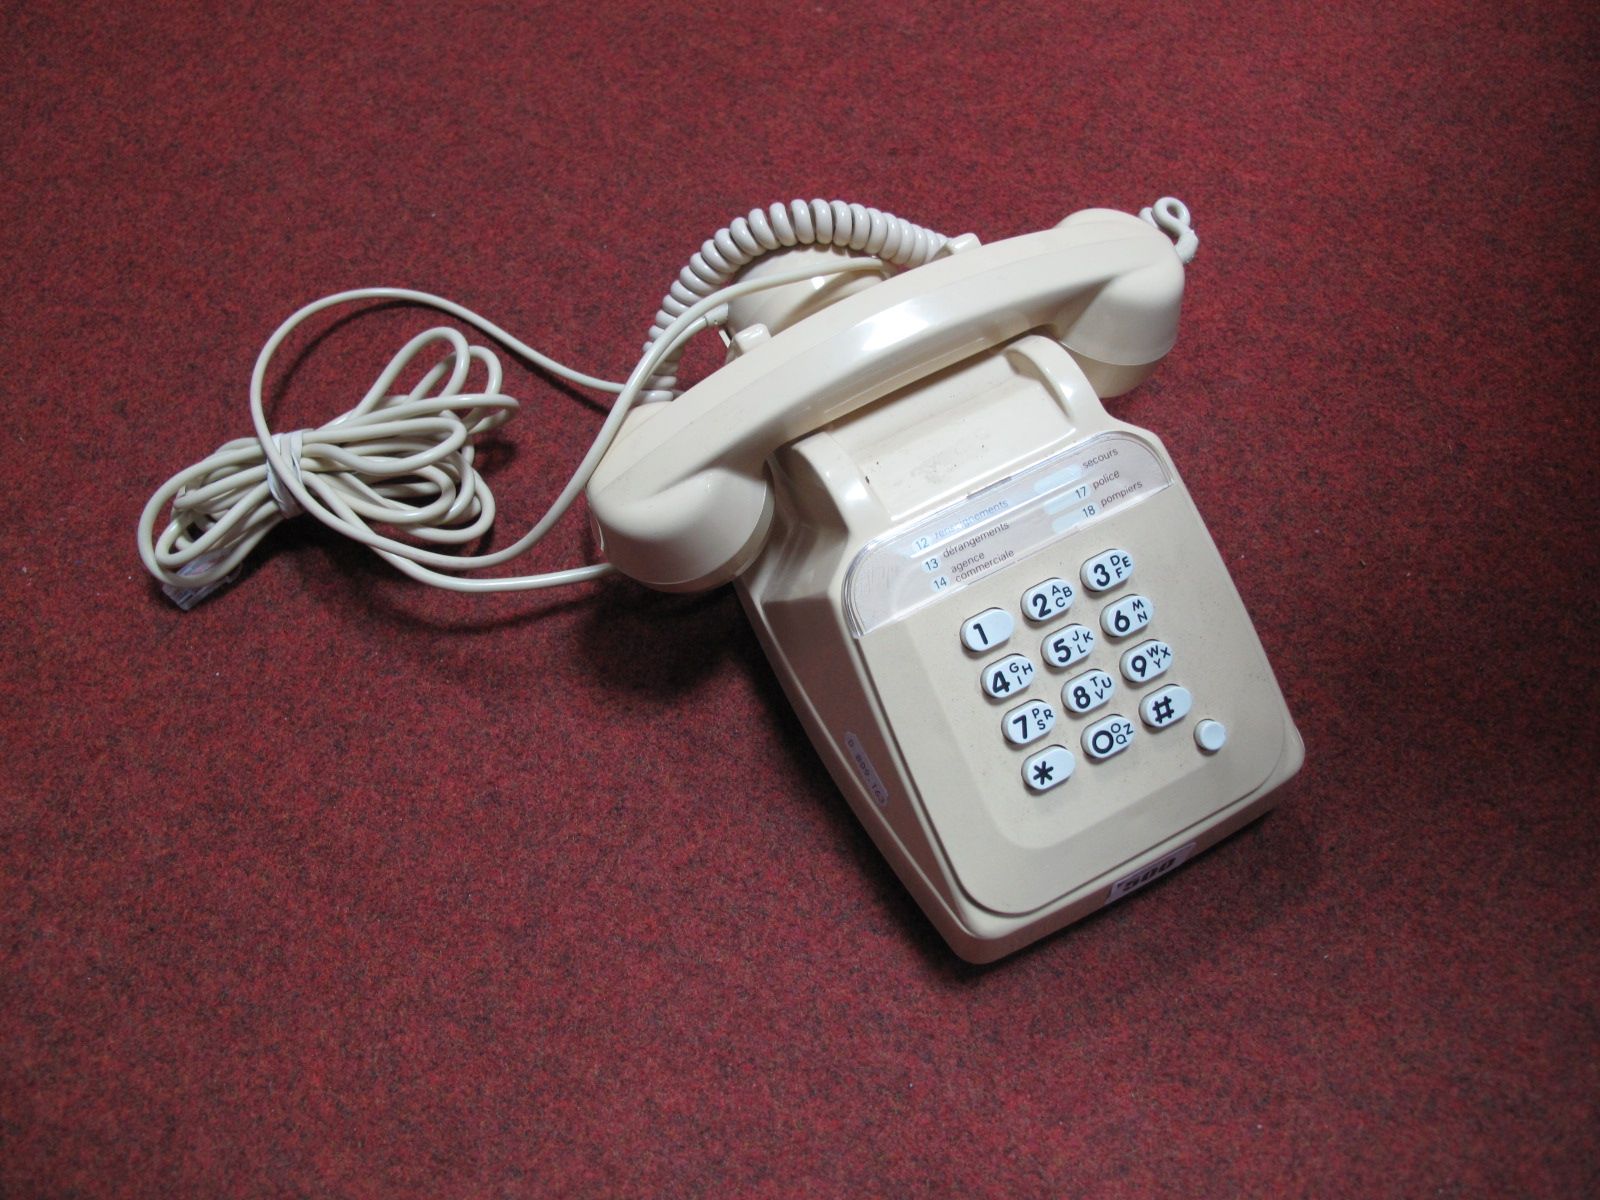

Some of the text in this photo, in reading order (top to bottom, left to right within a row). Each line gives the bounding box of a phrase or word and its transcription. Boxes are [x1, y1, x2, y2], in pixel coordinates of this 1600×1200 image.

[1082, 448, 1119, 469] secours
[1075, 470, 1120, 499] 17 police
[1082, 480, 1143, 518] 18 pompiers
[915, 500, 1009, 552] 12 rensignements
[925, 520, 1010, 572] 13 dérangements
[933, 552, 985, 590] 14 agence
[955, 549, 1015, 583] commerciale
[1093, 563, 1111, 587] 3
[1032, 593, 1052, 618] 2
[972, 622, 989, 645] 1
[1114, 609, 1130, 633] 6
[1053, 638, 1072, 663] 5
[1131, 655, 1147, 678] 9
[992, 670, 1011, 694] 4
[1073, 685, 1091, 710] 8
[1012, 714, 1028, 740] 7
